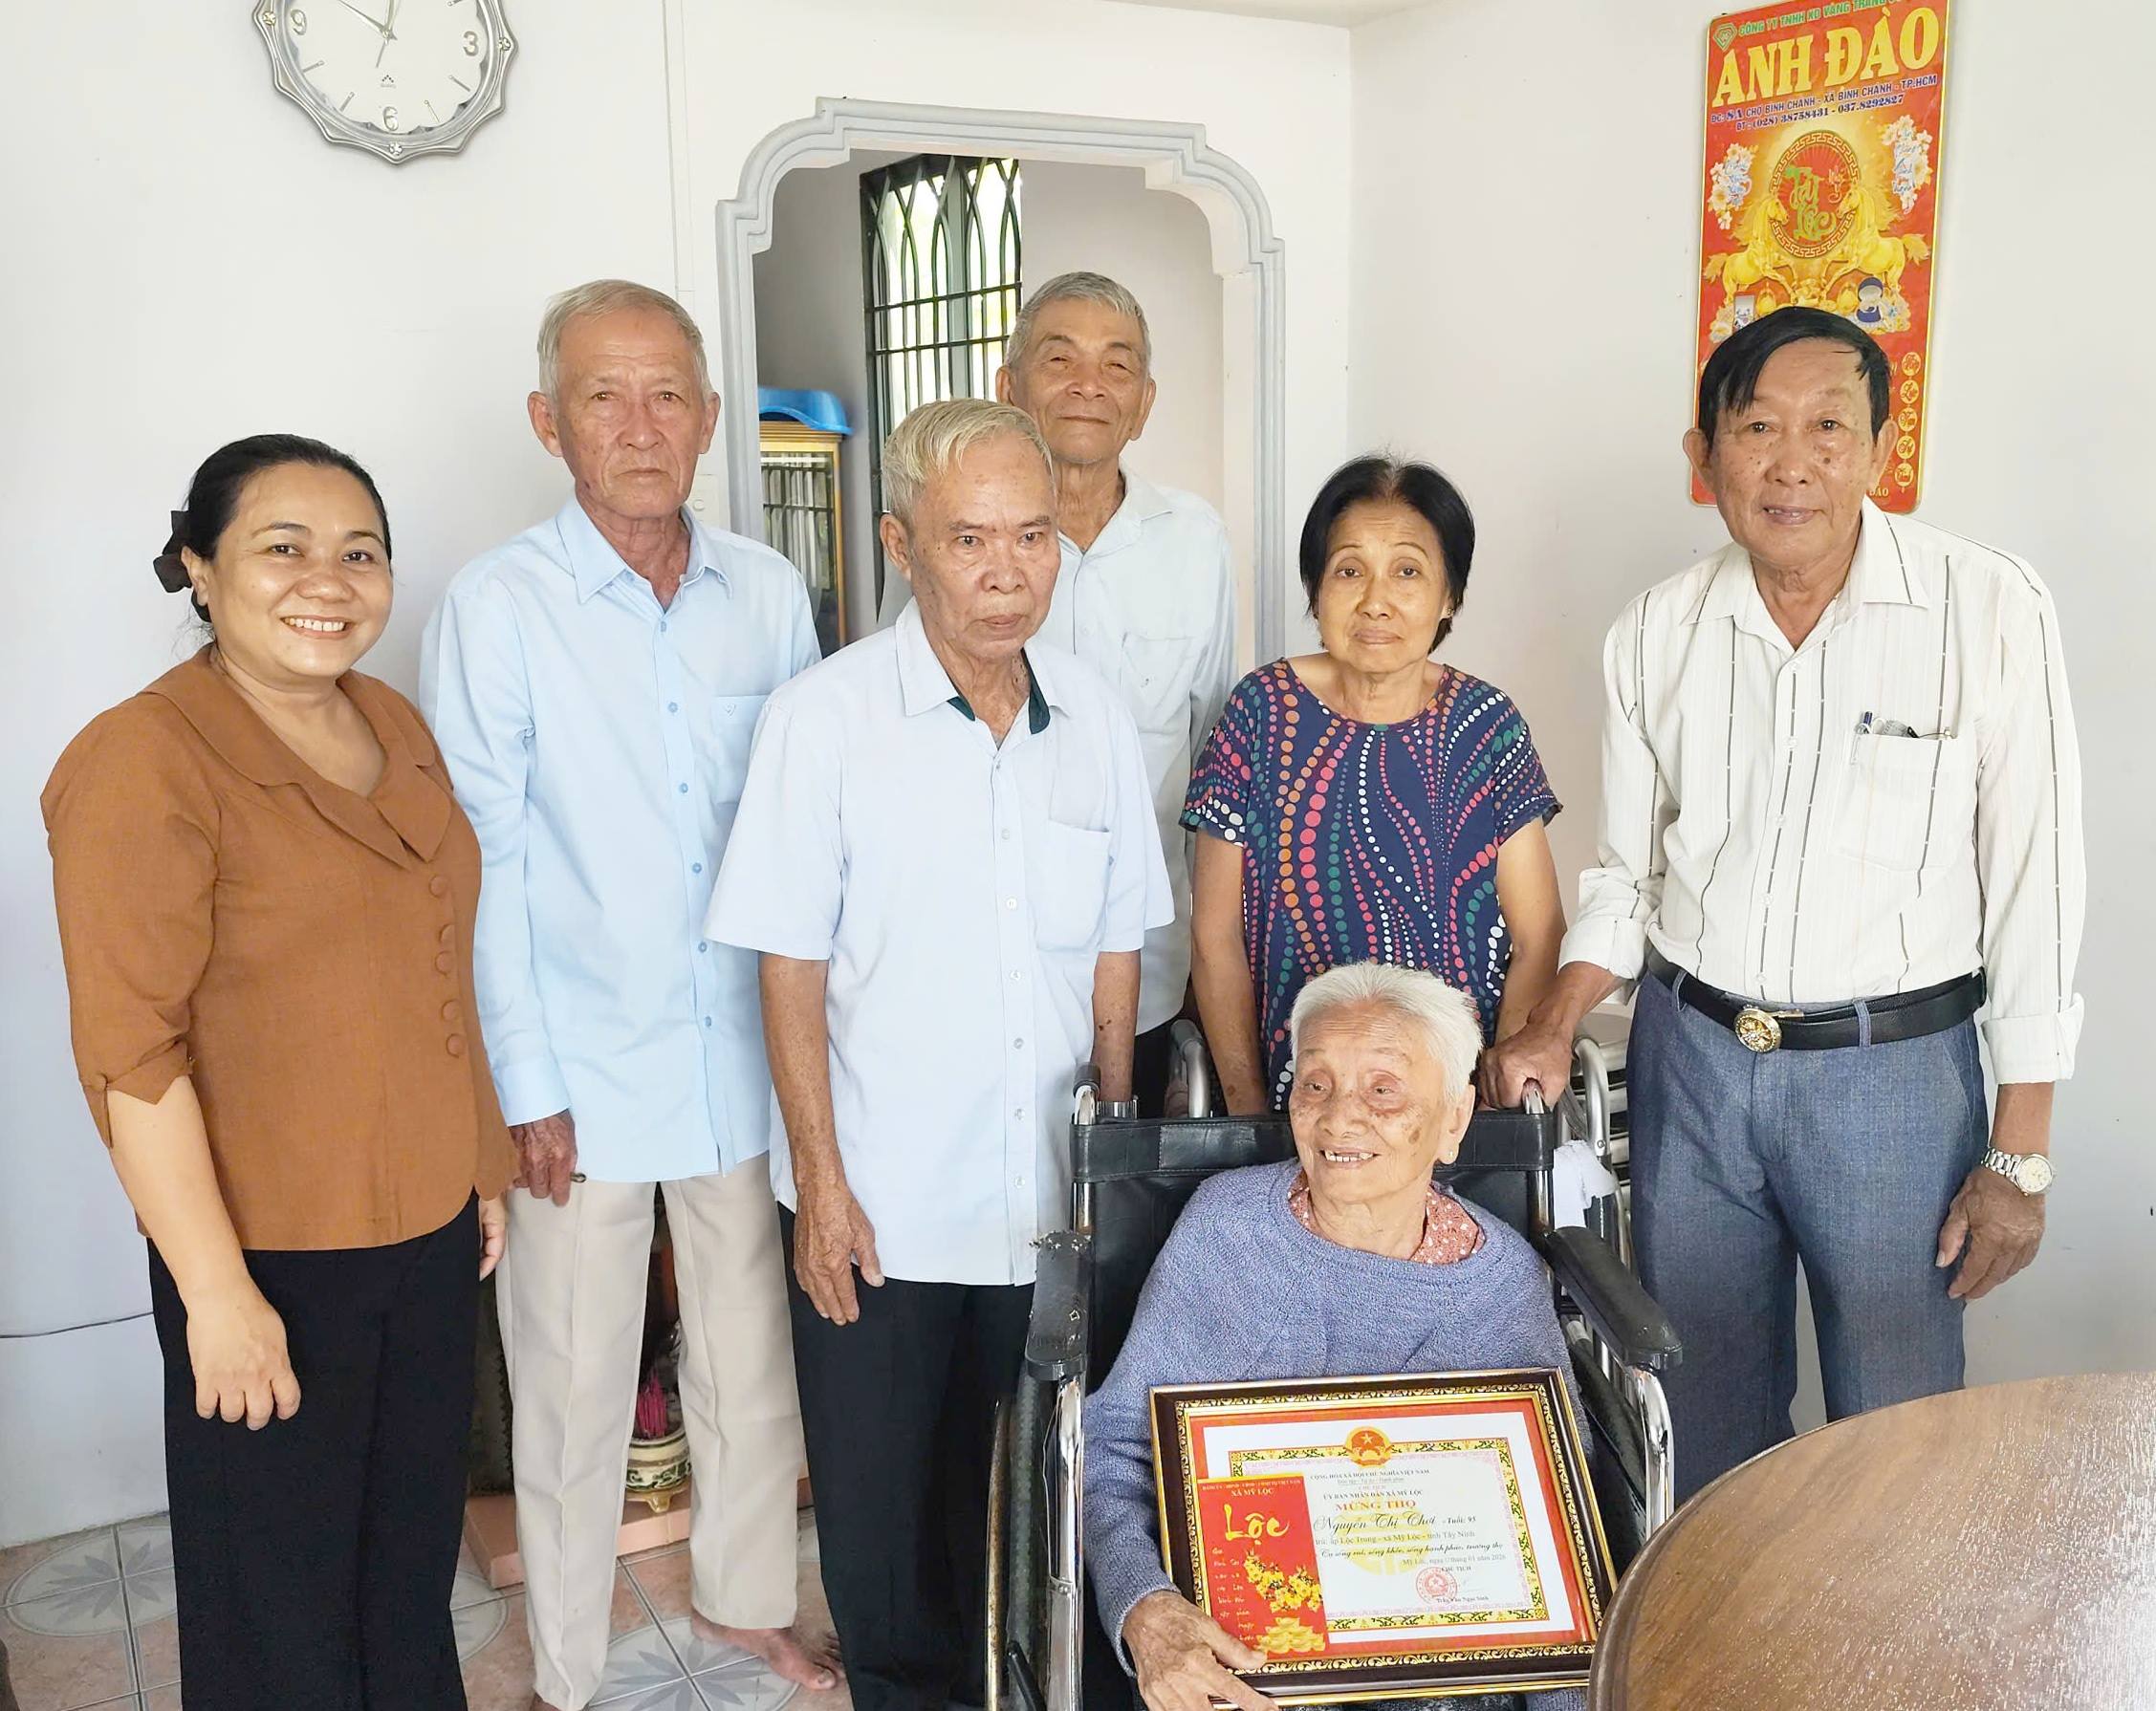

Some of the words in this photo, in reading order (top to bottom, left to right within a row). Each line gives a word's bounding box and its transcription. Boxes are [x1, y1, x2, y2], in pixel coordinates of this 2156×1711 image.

[290, 9, 307, 35] 9
[463, 31, 479, 56] 3
[1824, 7, 1940, 87] ĐÀO
[1902, 75, 1937, 89] TP.HCM
[382, 106, 399, 132] 6
[1224, 1504, 1290, 1546] Lộc
